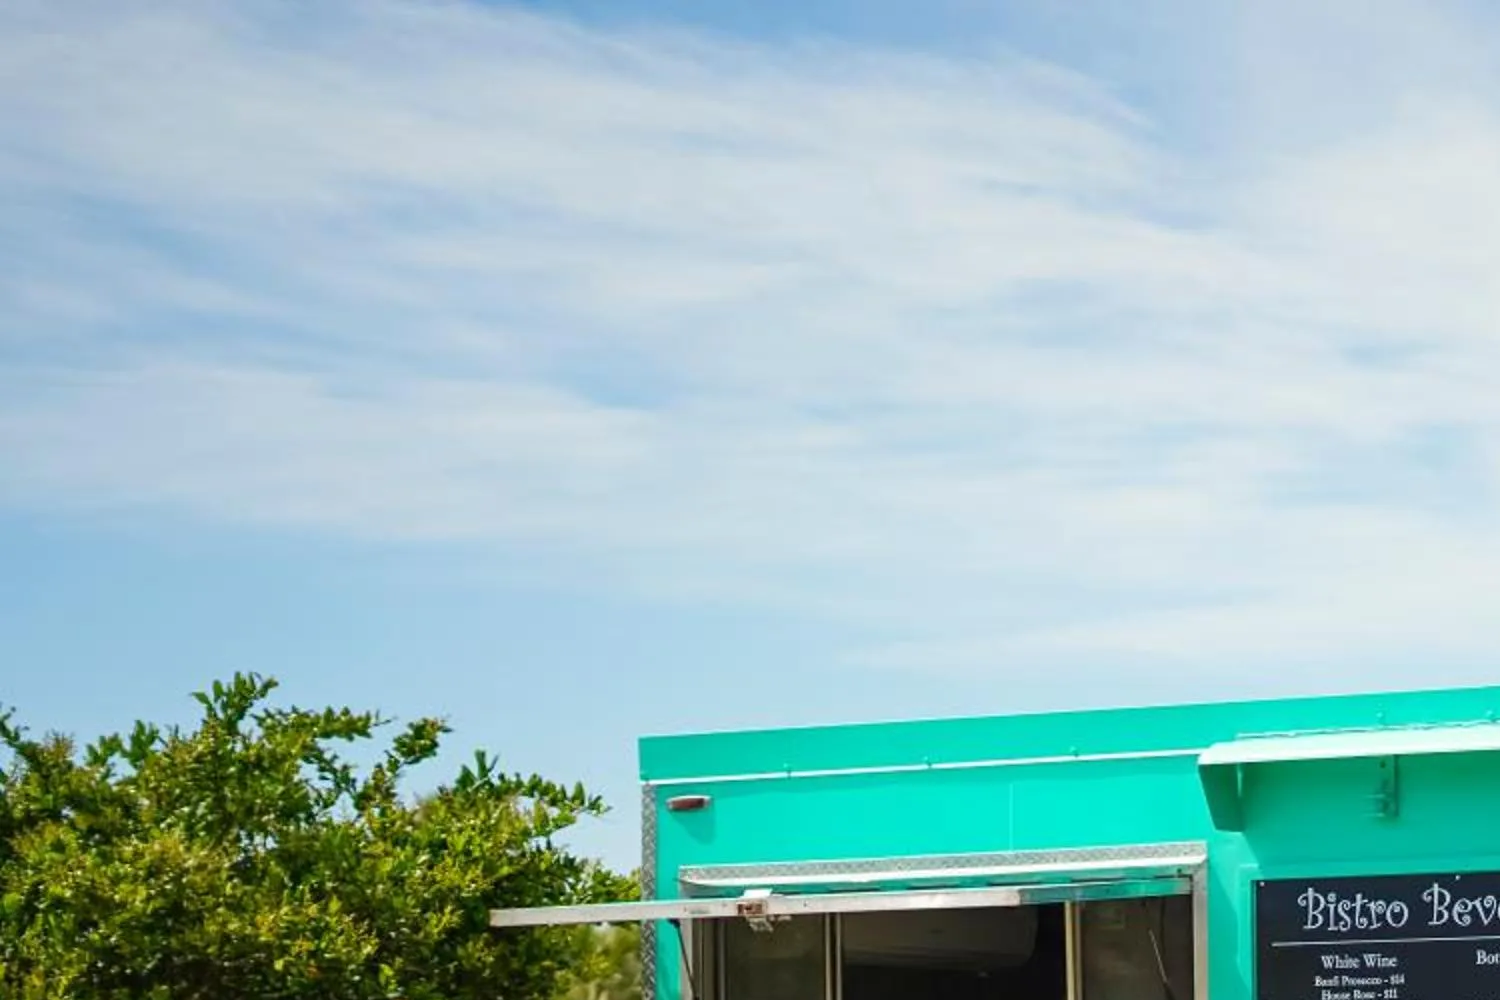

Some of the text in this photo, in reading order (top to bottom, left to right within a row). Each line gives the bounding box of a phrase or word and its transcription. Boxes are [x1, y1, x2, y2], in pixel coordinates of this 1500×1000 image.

[1298, 887, 1408, 931] Bistro
[1321, 954, 1398, 968] White Wine
[1384, 989, 1398, 998] $11
